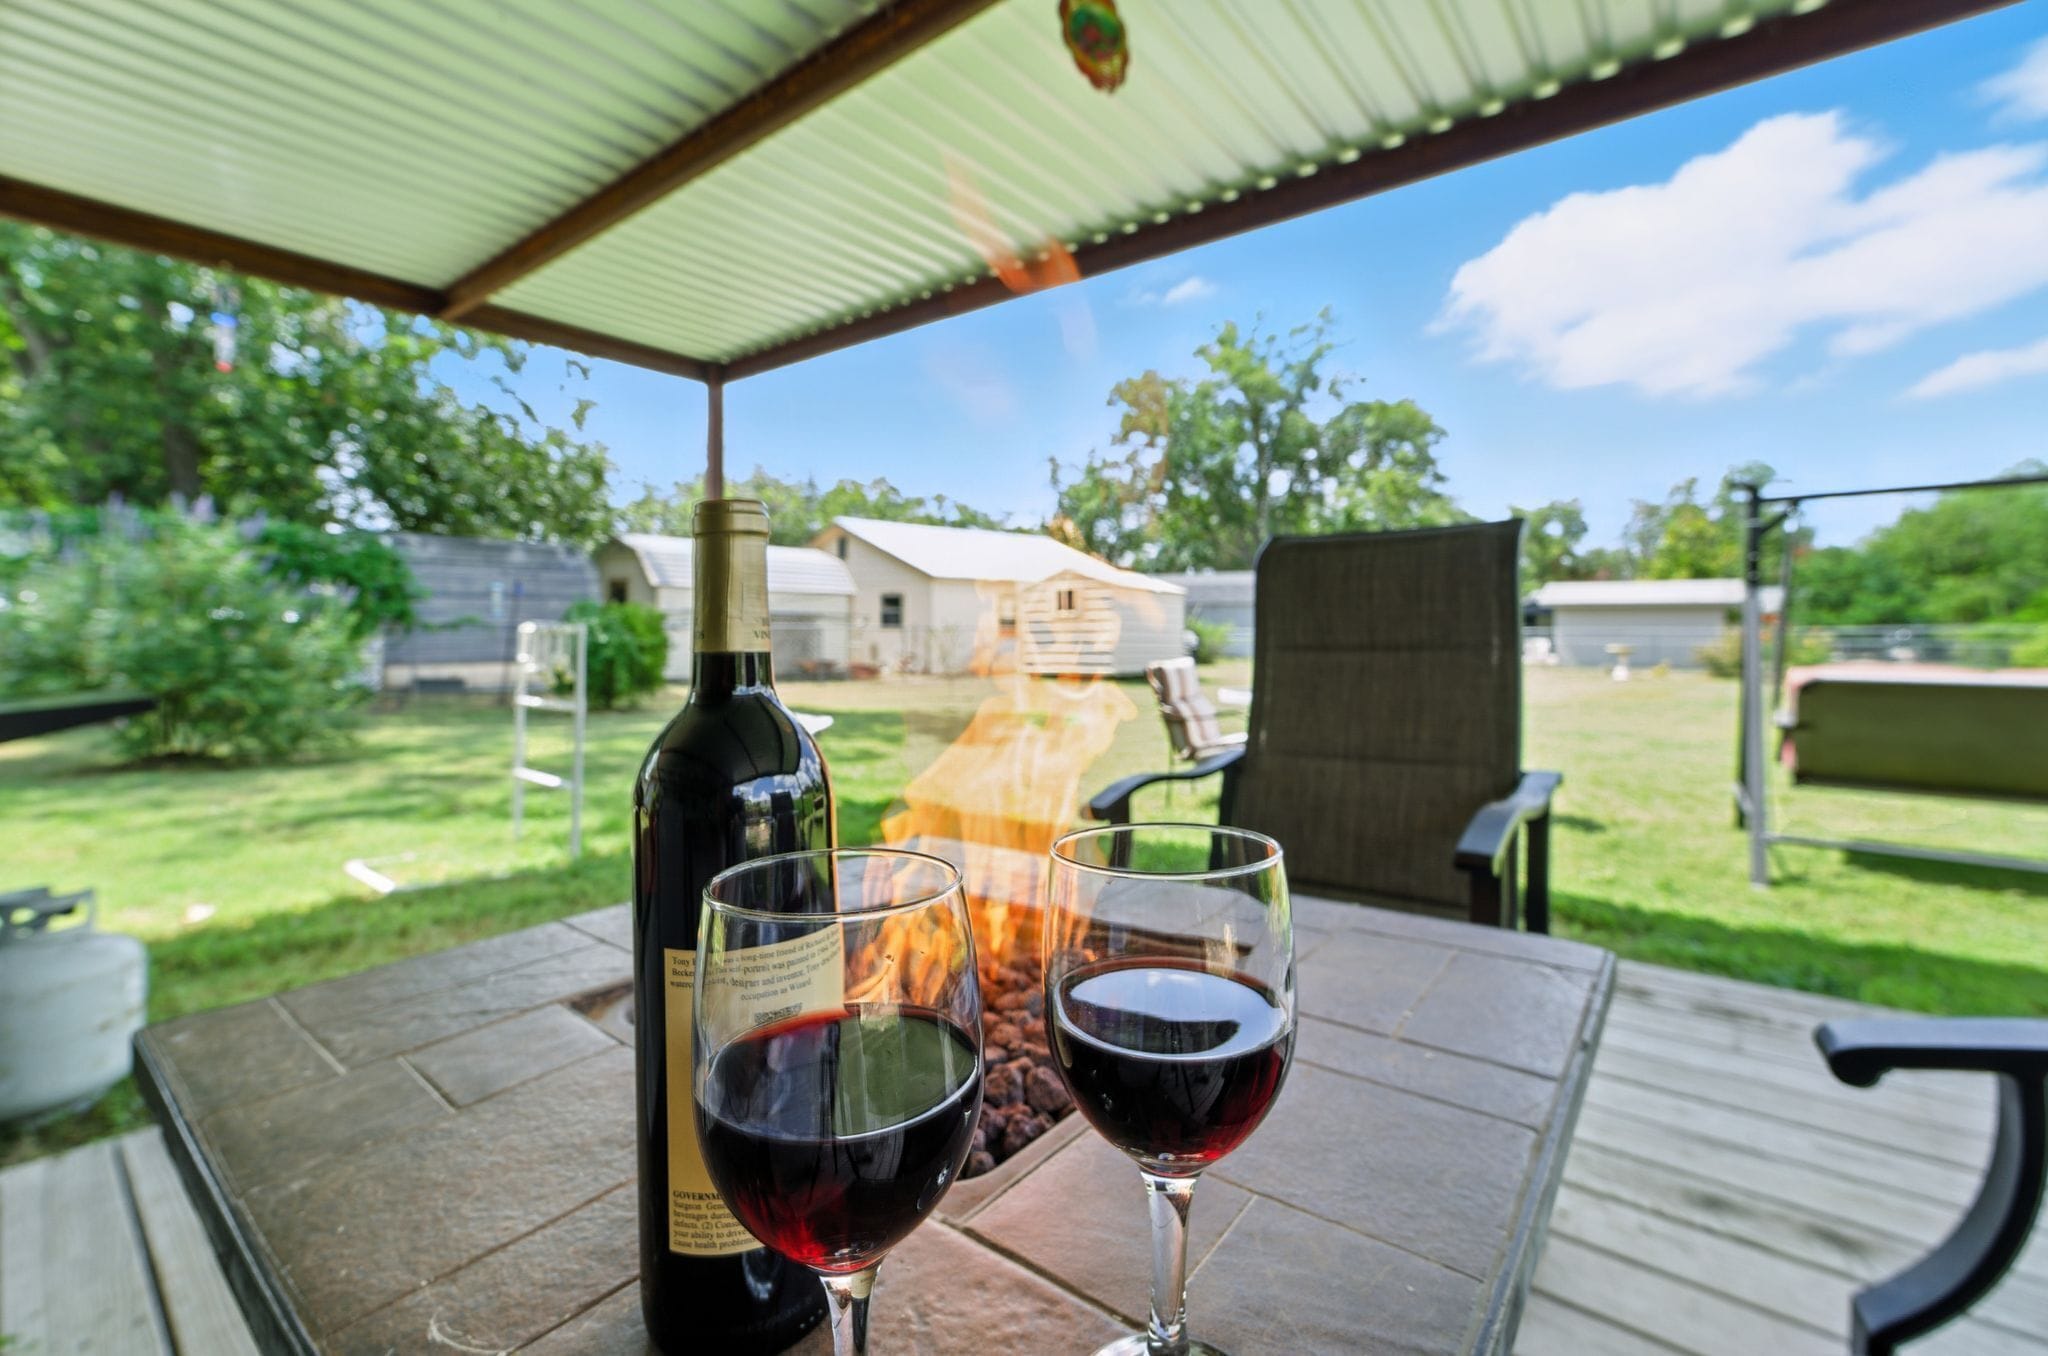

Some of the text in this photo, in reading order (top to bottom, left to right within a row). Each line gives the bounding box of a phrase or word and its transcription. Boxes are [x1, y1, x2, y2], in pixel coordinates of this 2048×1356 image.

[672, 956, 690, 967] Tony
[672, 967, 696, 977] Becke
[730, 977, 759, 989] designer
[741, 989, 779, 1001] occupation
[691, 1231, 714, 1241] ability
[694, 1240, 717, 1248] health
